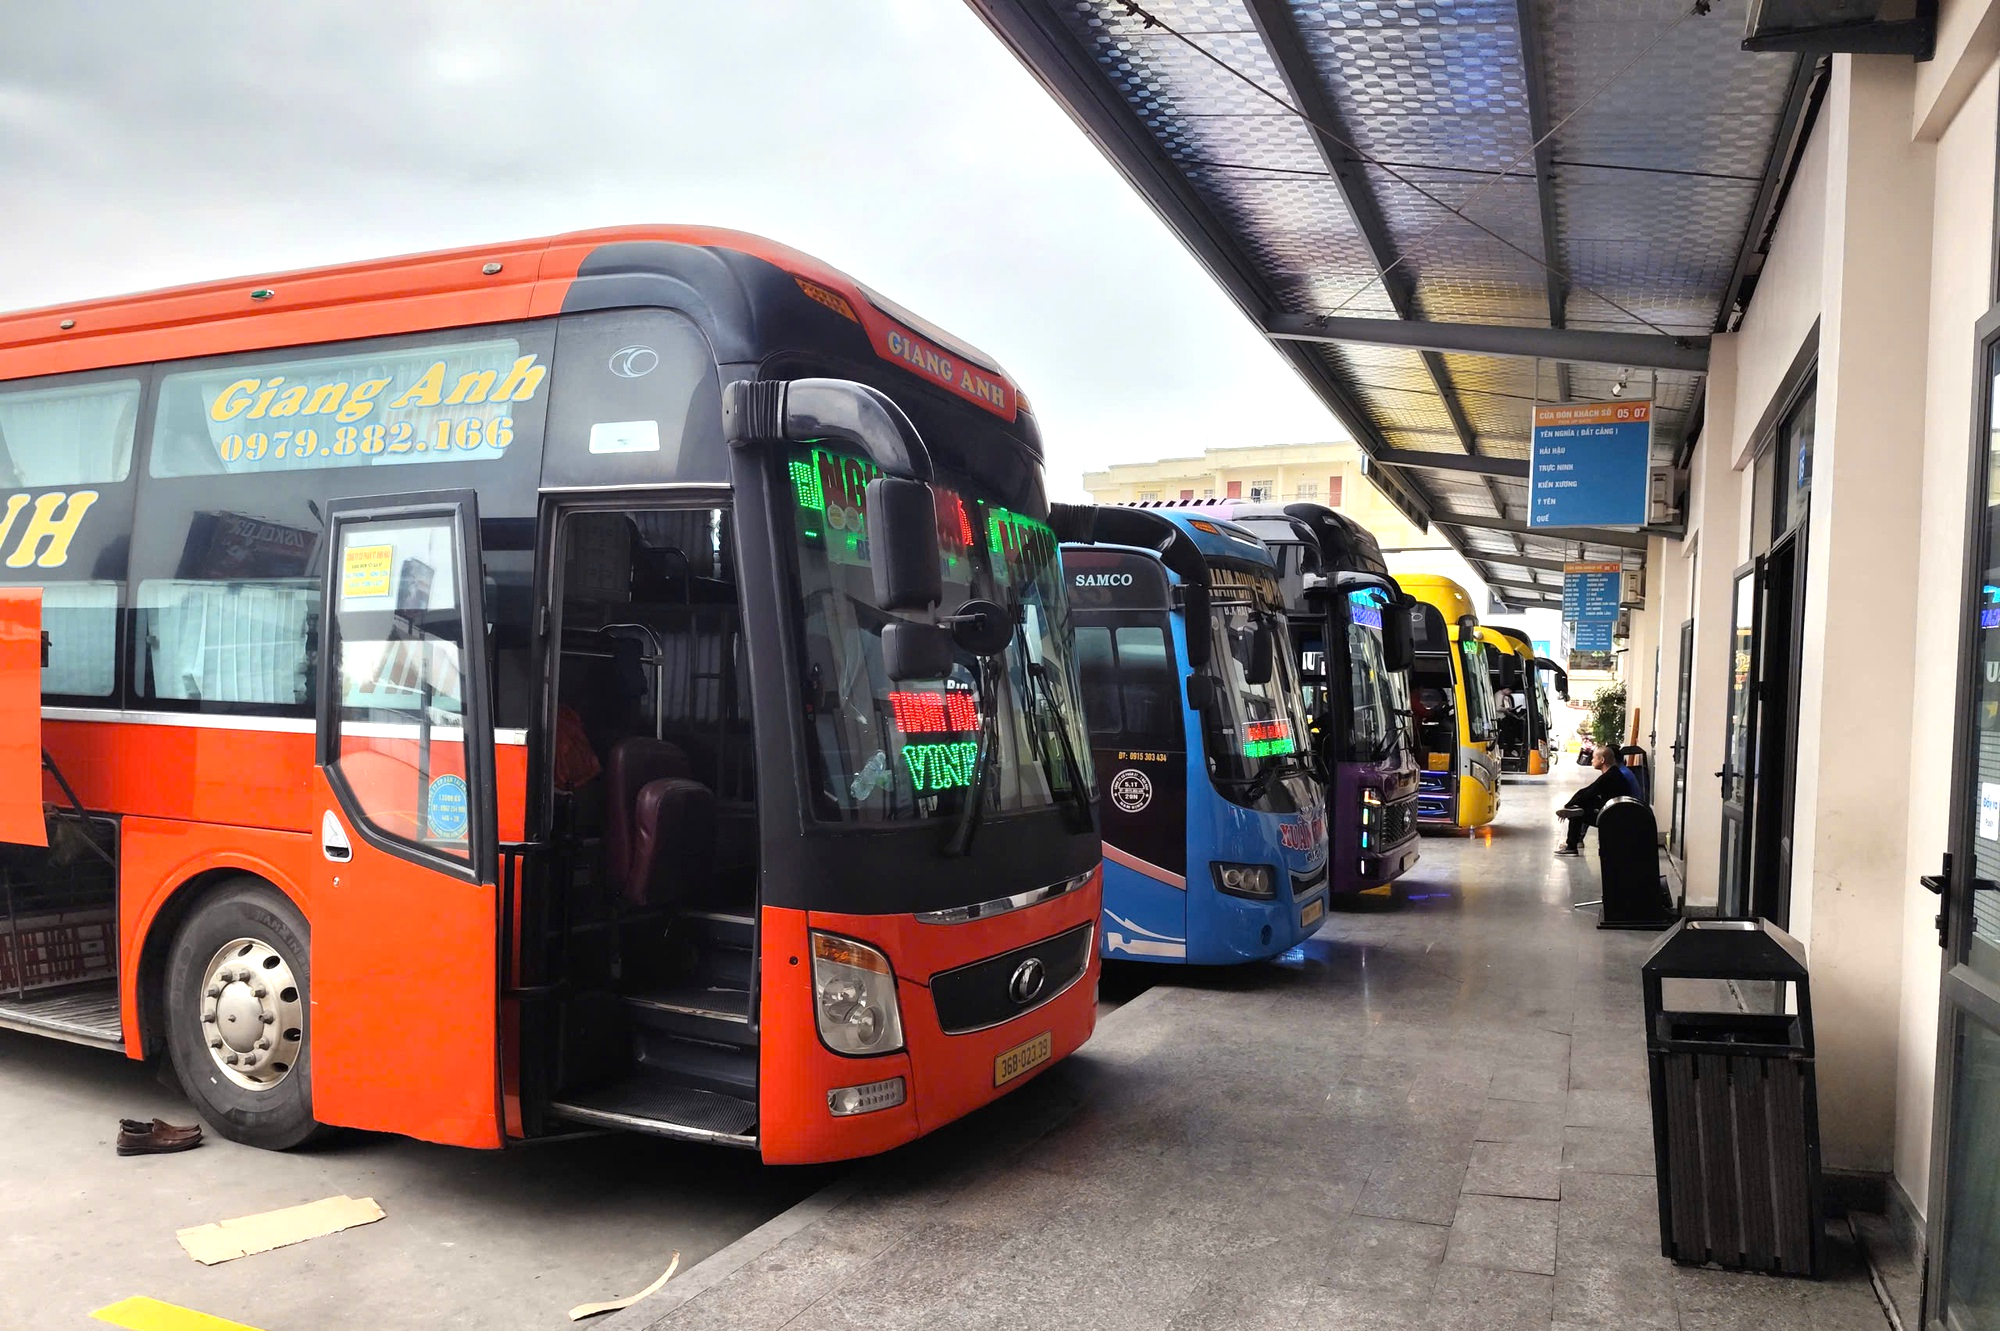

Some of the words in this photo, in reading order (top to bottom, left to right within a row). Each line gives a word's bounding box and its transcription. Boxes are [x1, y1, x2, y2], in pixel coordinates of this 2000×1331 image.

[888, 331, 953, 381] GIANG
[960, 370, 1006, 409] ANH
[210, 376, 394, 423] Giang
[388, 353, 547, 409] Anh
[1573, 408, 1600, 418] KHÁCH
[1600, 407, 1612, 416] SỐ
[1617, 408, 1629, 418] 05
[1634, 408, 1646, 418] 07
[219, 414, 514, 462] 0979.882.166
[1540, 429, 1553, 438] YÊN
[1554, 428, 1575, 437] NGHĨA
[1552, 446, 1566, 456] HẬU
[1538, 464, 1556, 473] TRỰC
[1556, 463, 1574, 471] NINH
[1536, 513, 1550, 523] QUẾ
[1075, 573, 1133, 587] SAMCO
